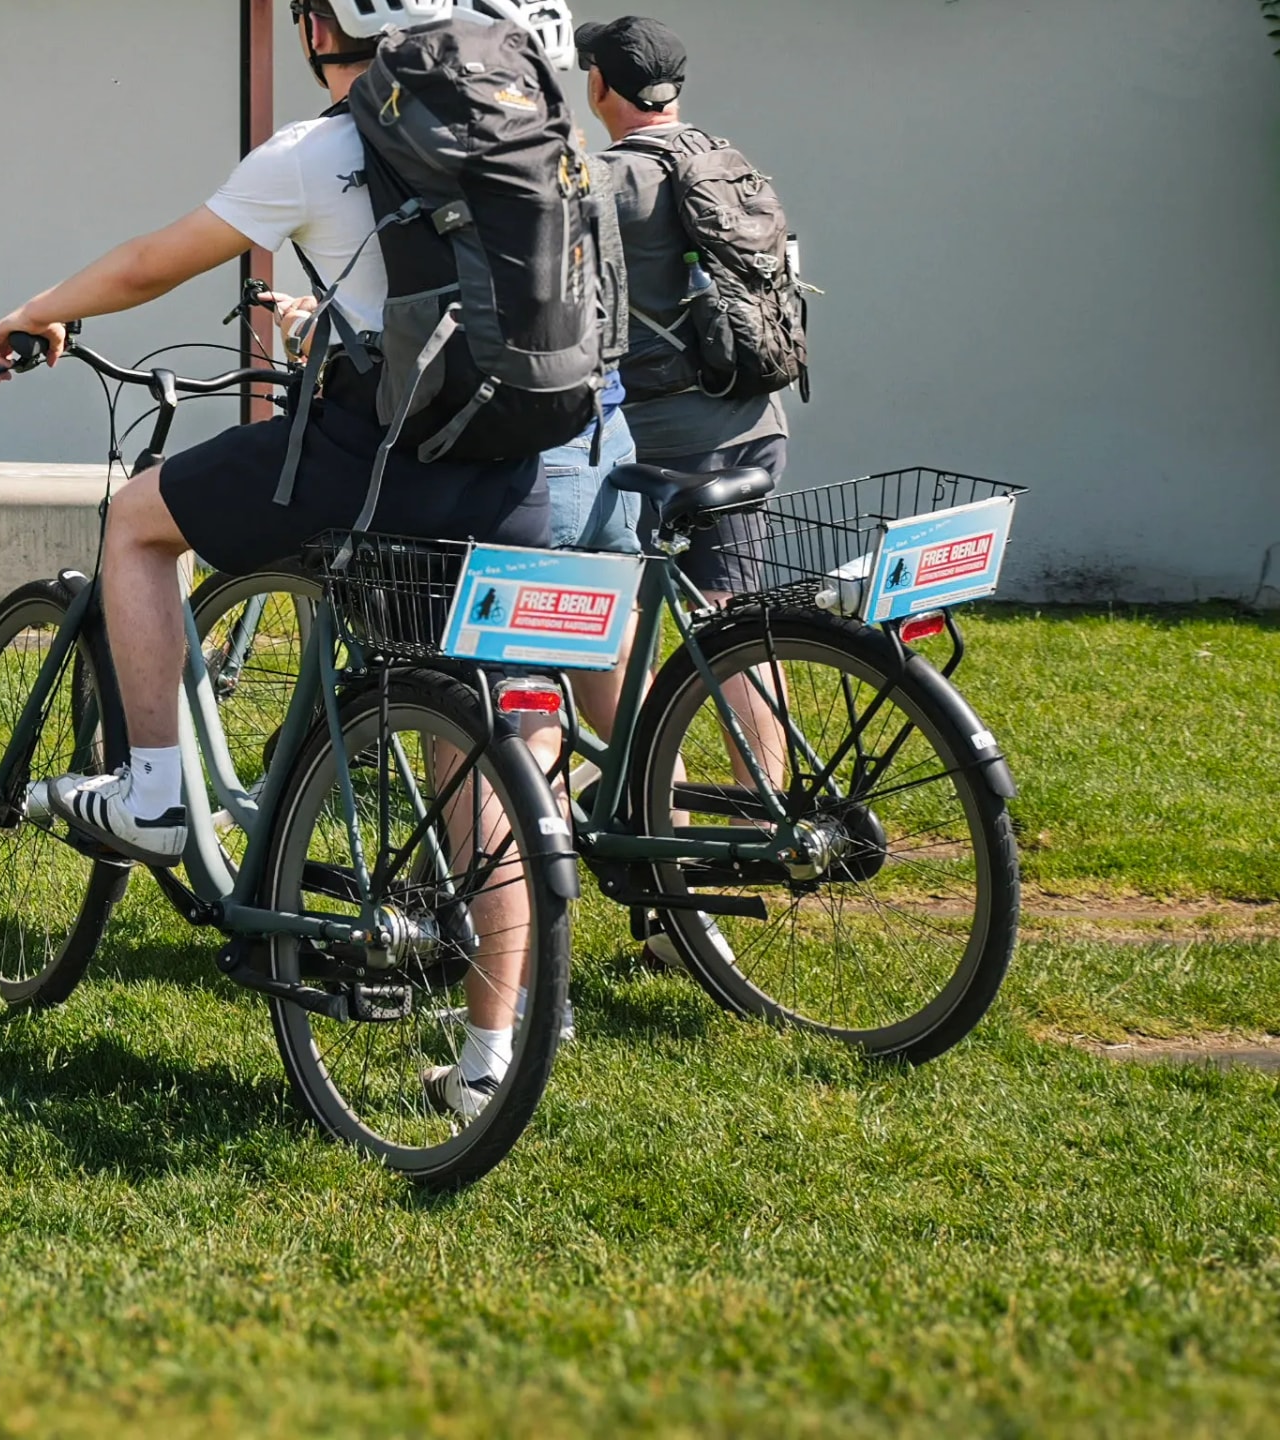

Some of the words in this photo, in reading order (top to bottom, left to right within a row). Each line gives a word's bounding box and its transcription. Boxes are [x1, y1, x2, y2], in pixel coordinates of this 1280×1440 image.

[920, 546, 951, 568] FREE
[949, 536, 991, 561] BERLIN
[518, 590, 559, 612] FREE
[557, 592, 611, 616] BERLIN
